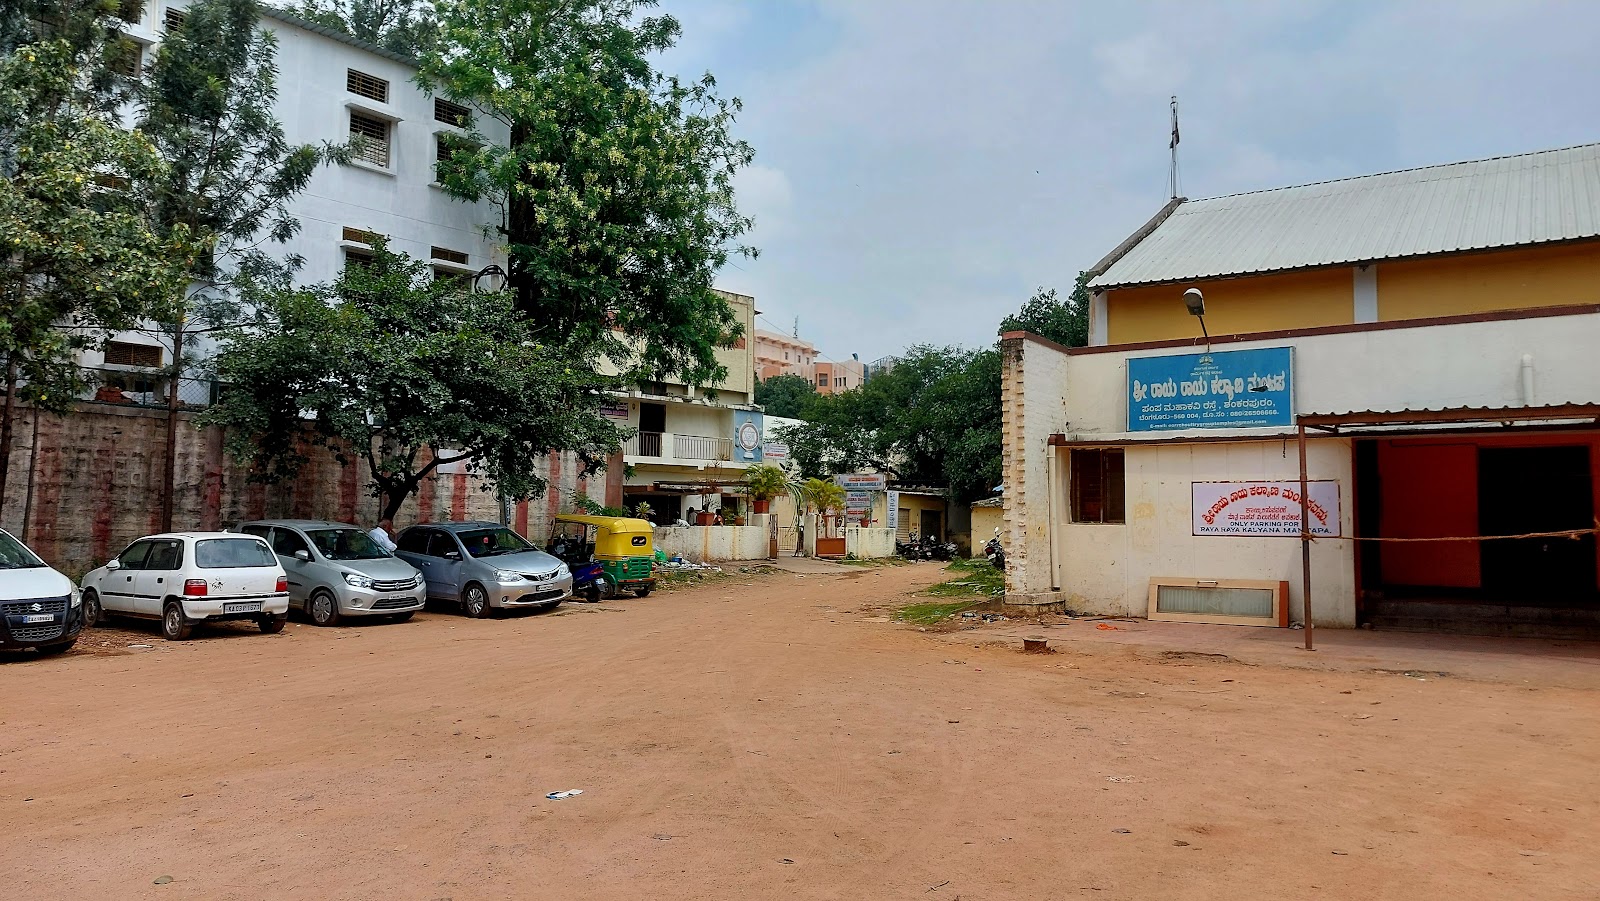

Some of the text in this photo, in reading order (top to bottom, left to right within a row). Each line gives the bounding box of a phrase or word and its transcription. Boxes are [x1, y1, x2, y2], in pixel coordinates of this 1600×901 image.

[1132, 379, 1148, 402] ಶ್ರೀ
[1150, 377, 1177, 398] ರಾಯ
[1180, 376, 1208, 397] ರಾಯ
[1210, 374, 1244, 401] ಕಲ್ಯಾಣ
[1141, 404, 1162, 413] ಪಂಪ
[1163, 402, 1201, 411] ಮಹಾಕವಿ
